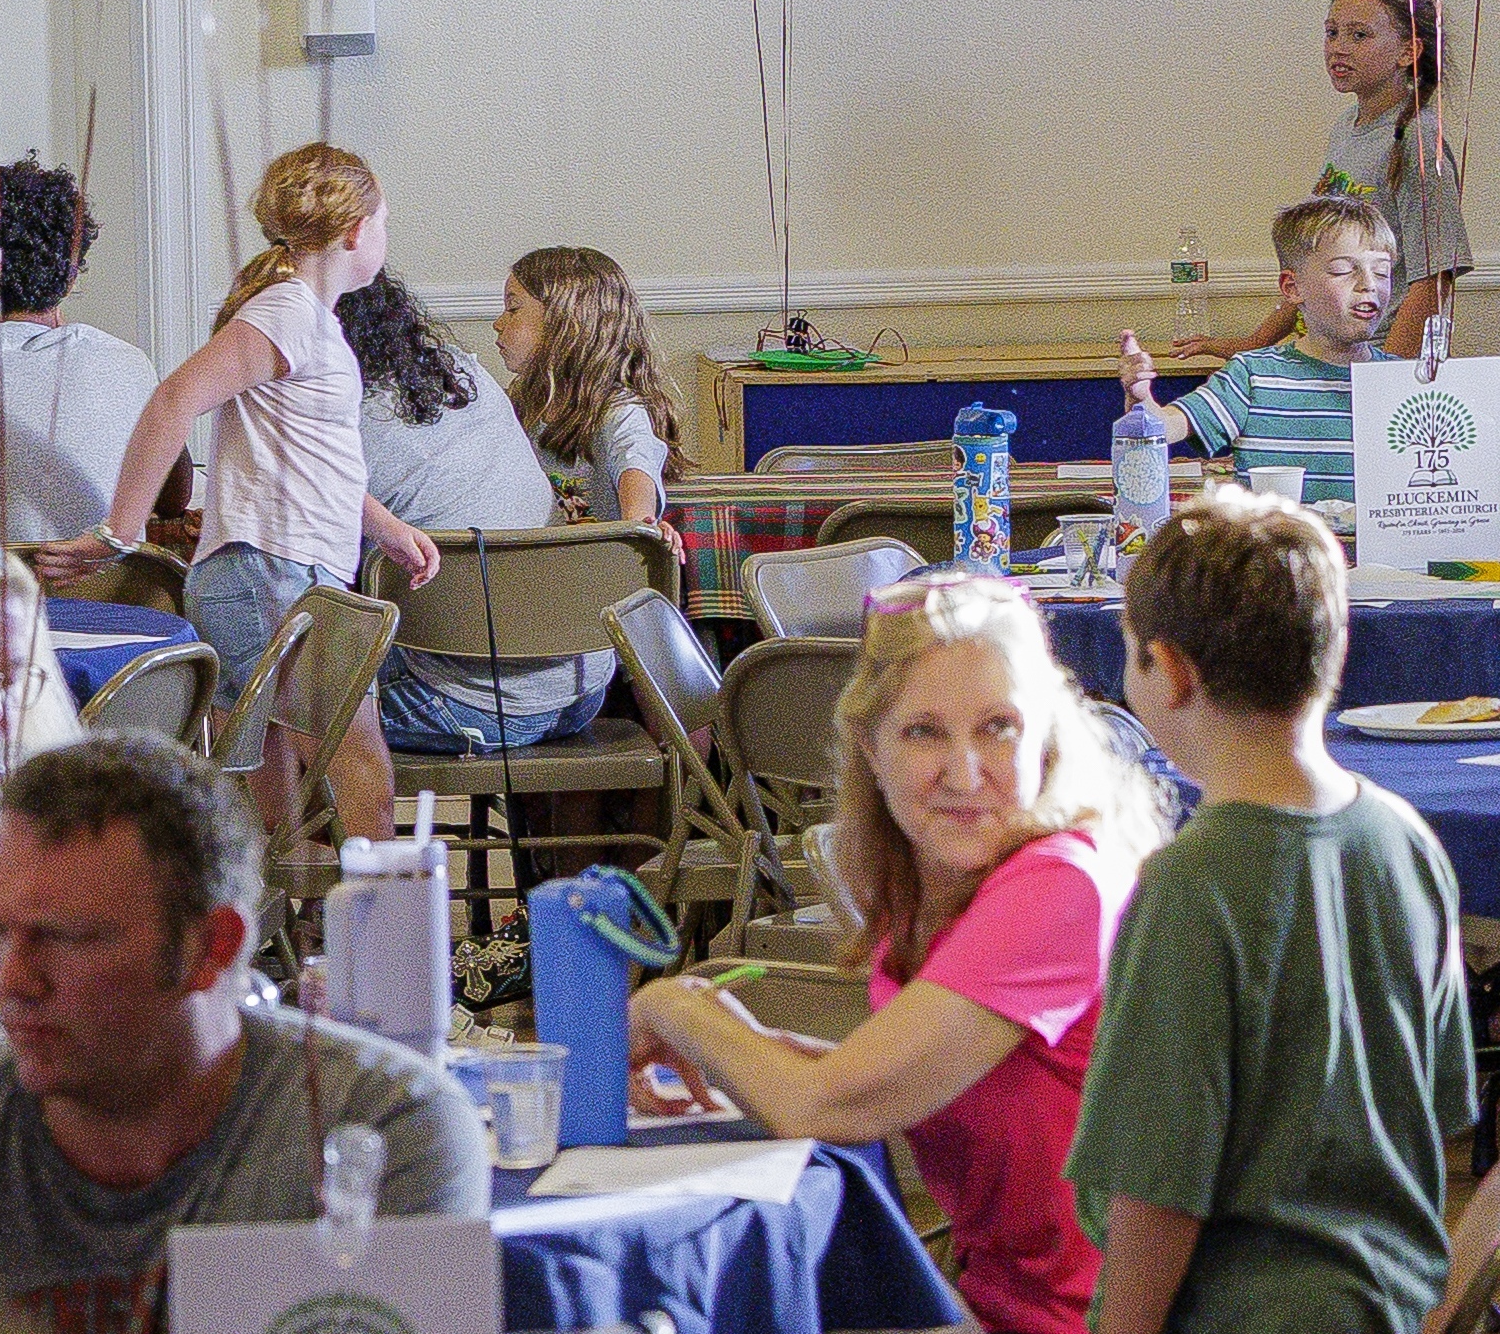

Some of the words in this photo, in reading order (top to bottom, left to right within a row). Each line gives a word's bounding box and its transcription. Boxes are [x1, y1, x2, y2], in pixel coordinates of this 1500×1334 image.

[1414, 449, 1451, 469] 175
[1386, 489, 1480, 506] PLUCKEMIN
[1368, 505, 1449, 519] PRESBYTERIAN
[1450, 503, 1498, 515] CHURCH
